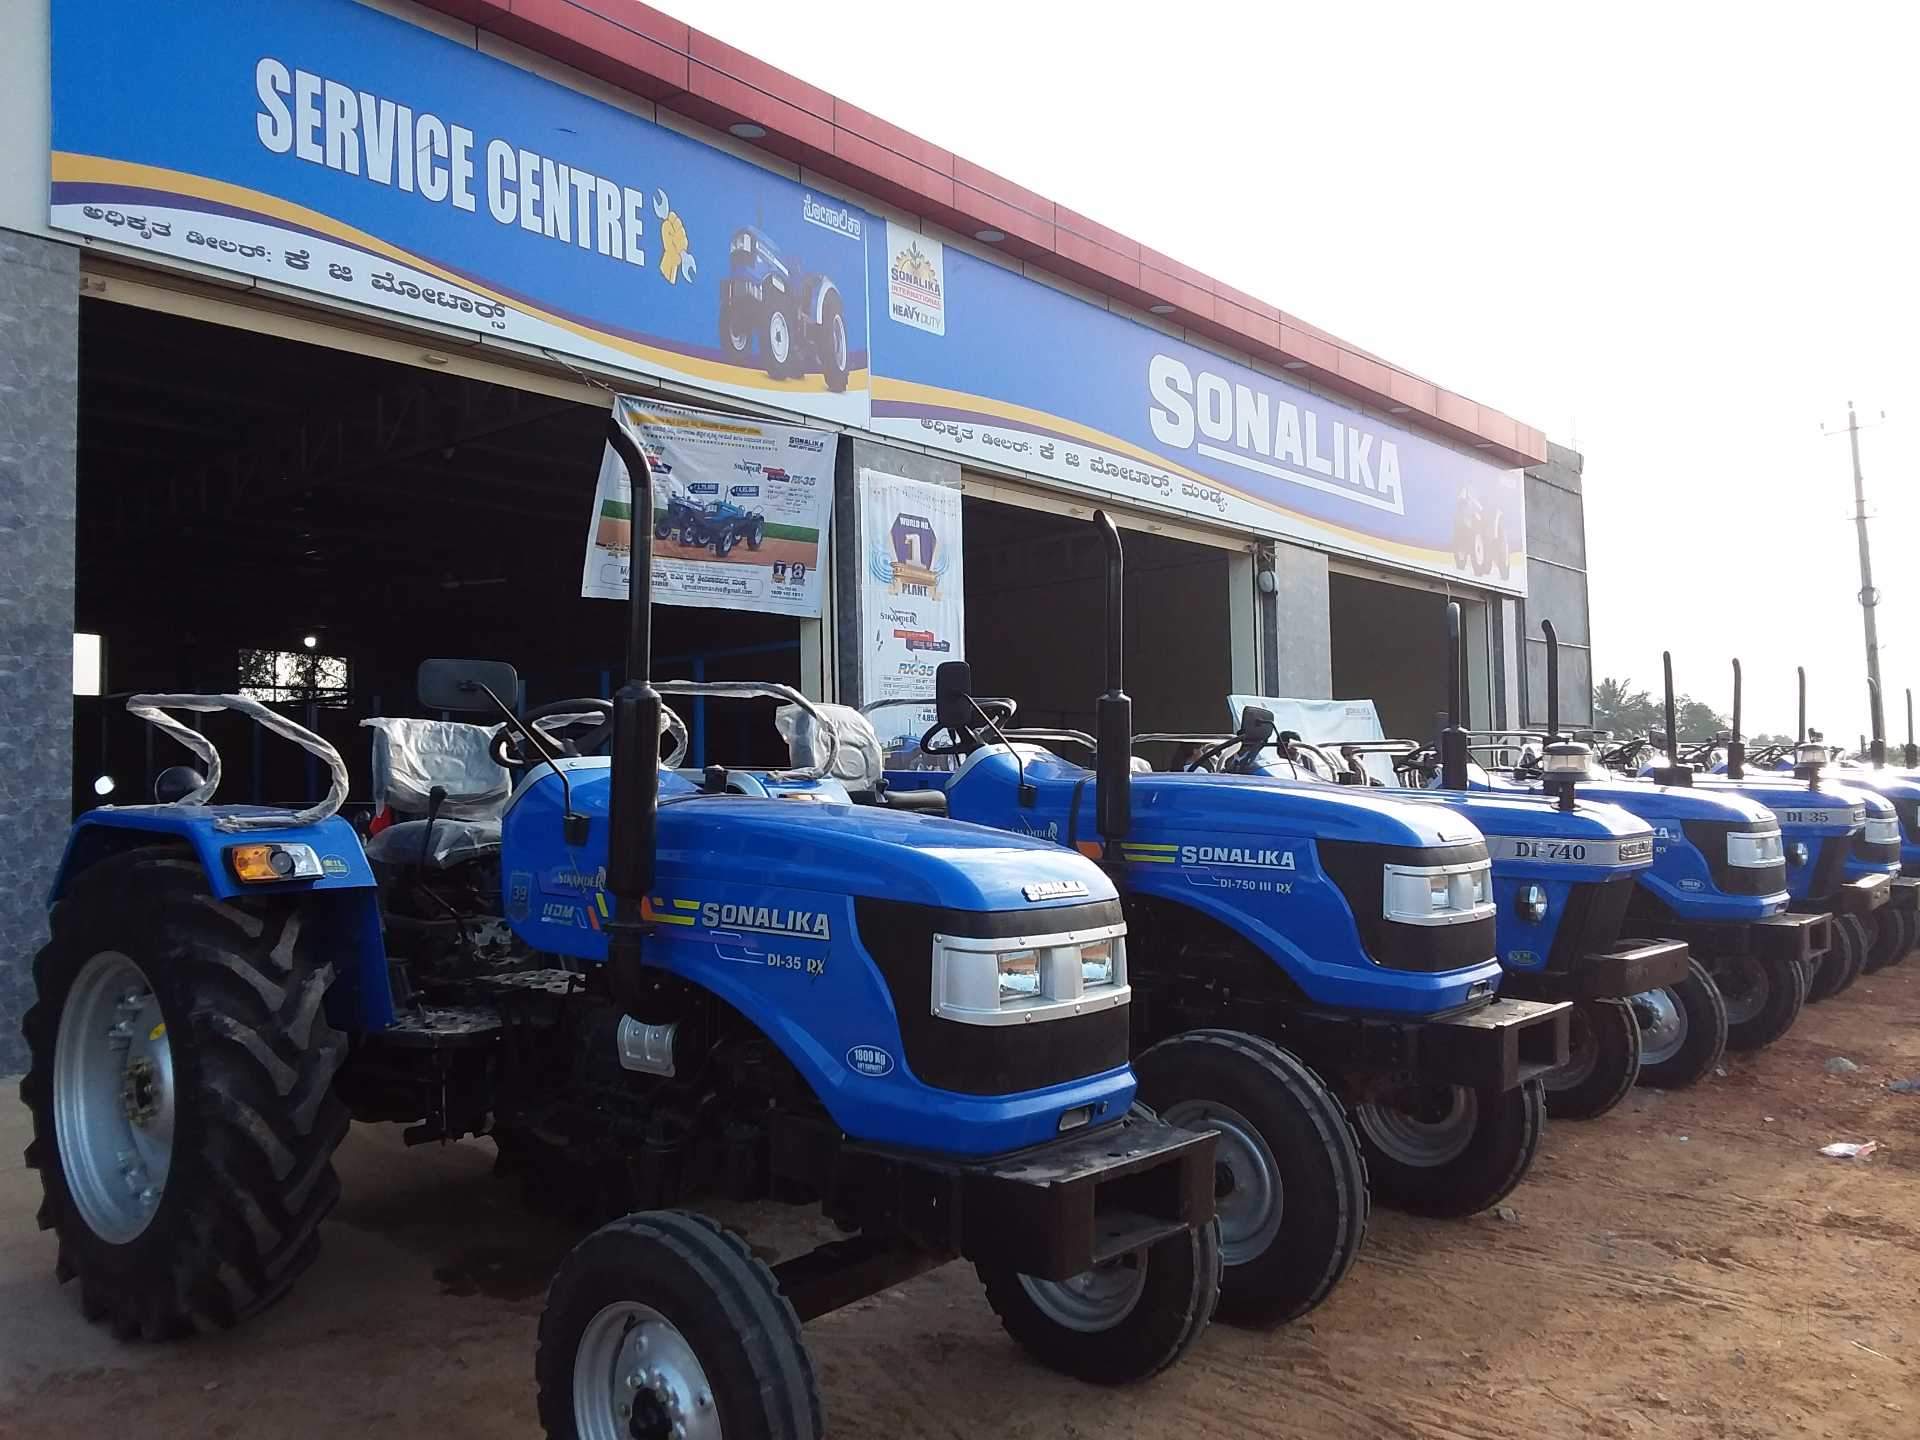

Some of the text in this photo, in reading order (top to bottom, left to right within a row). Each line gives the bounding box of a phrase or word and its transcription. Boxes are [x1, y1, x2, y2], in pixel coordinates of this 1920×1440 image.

[255, 57, 645, 267] SERVICE CENTRE
[83, 205, 172, 240] ಅಧಿಕೃತ
[185, 230, 272, 263] ಡೀಲರ್:
[284, 249, 310, 271] ಕೆ
[328, 263, 354, 283] ಜಿ
[891, 267, 941, 297] SONALIKA
[920, 416, 974, 443] ಅಧಿಕೃತ
[1039, 442, 1056, 460] ಕೆ
[1065, 452, 1080, 468] ಜಿ
[1149, 354, 1405, 515] SONALIKA
[900, 517, 921, 529] WORLD
[904, 533, 926, 568] 1
[902, 583, 928, 597] PLANT
[1809, 811, 1829, 823] 35
[1181, 846, 1296, 870] SONALIKA
[1515, 841, 1586, 860] DI-740
[1220, 879, 1294, 894] DI-750 III RX
[702, 902, 830, 941] SONALIKA
[767, 953, 825, 976] DI-35 RX
[854, 1049, 873, 1063] 1800
